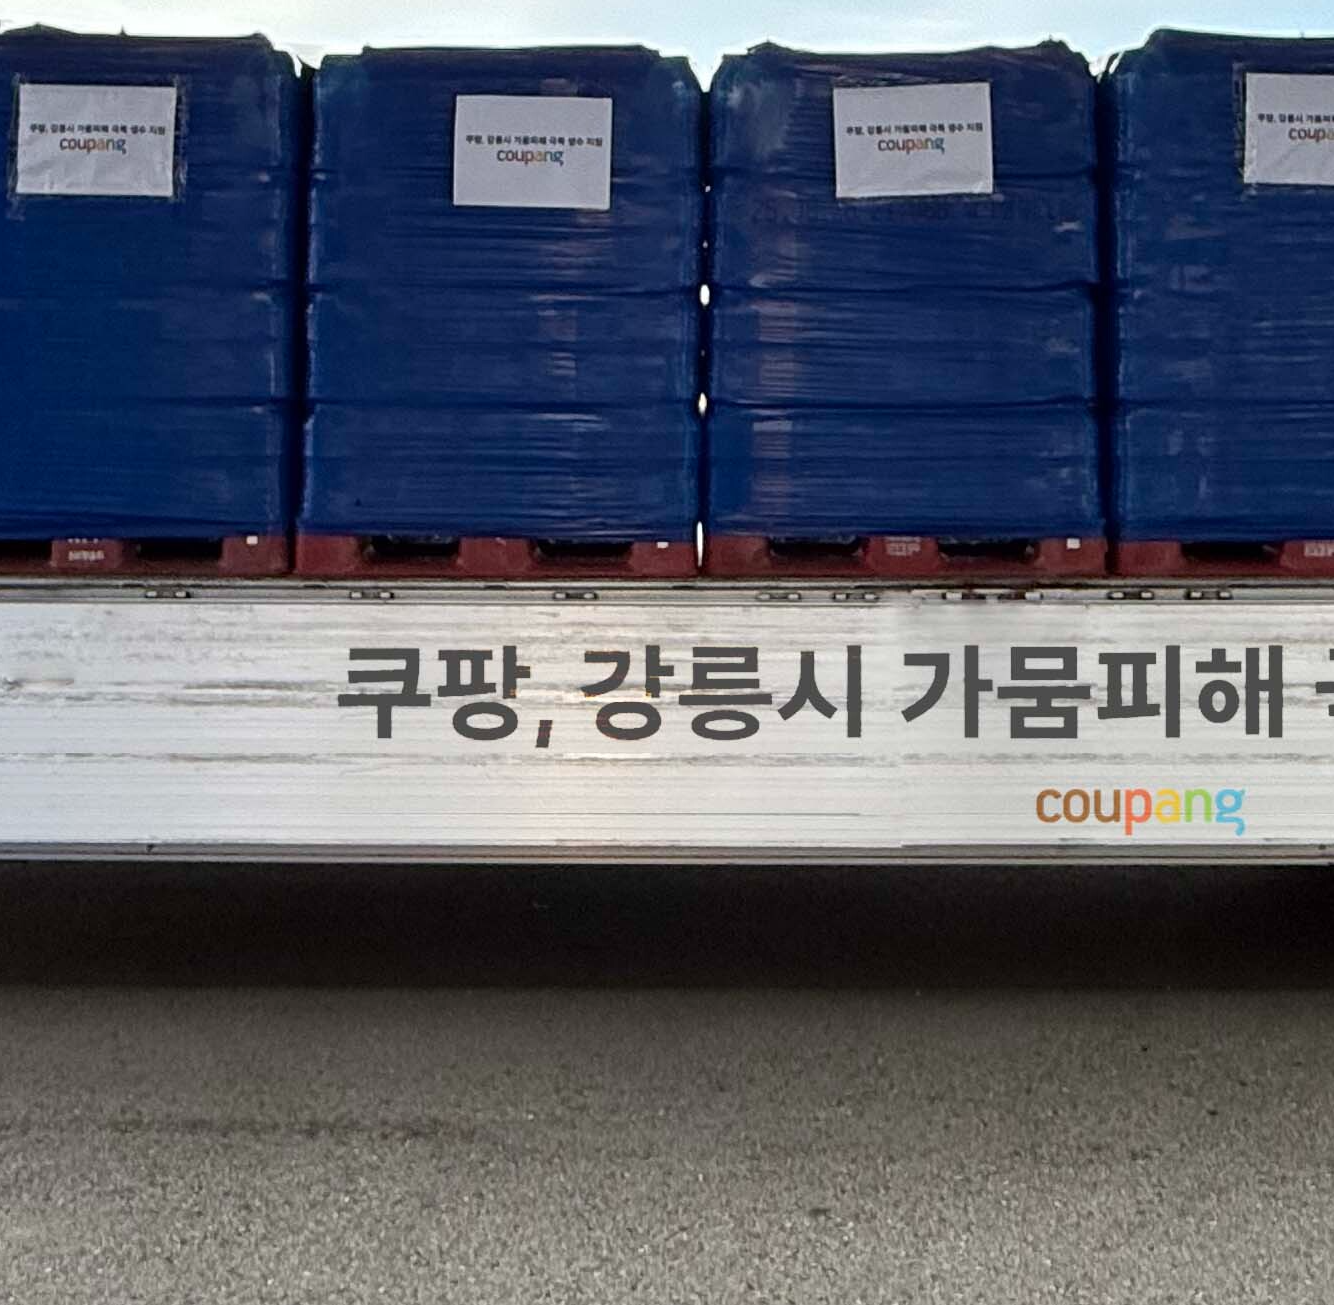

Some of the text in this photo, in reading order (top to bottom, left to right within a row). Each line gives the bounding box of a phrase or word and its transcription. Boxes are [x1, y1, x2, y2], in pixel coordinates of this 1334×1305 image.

[60, 138, 126, 154] coupang
[878, 138, 944, 154] coupang
[497, 150, 564, 166] coupang
[338, 645, 552, 748] 쿠팡,
[582, 645, 862, 741] 강릉시
[901, 645, 1283, 739] 가뭄피해
[1036, 786, 1246, 836] coupang
